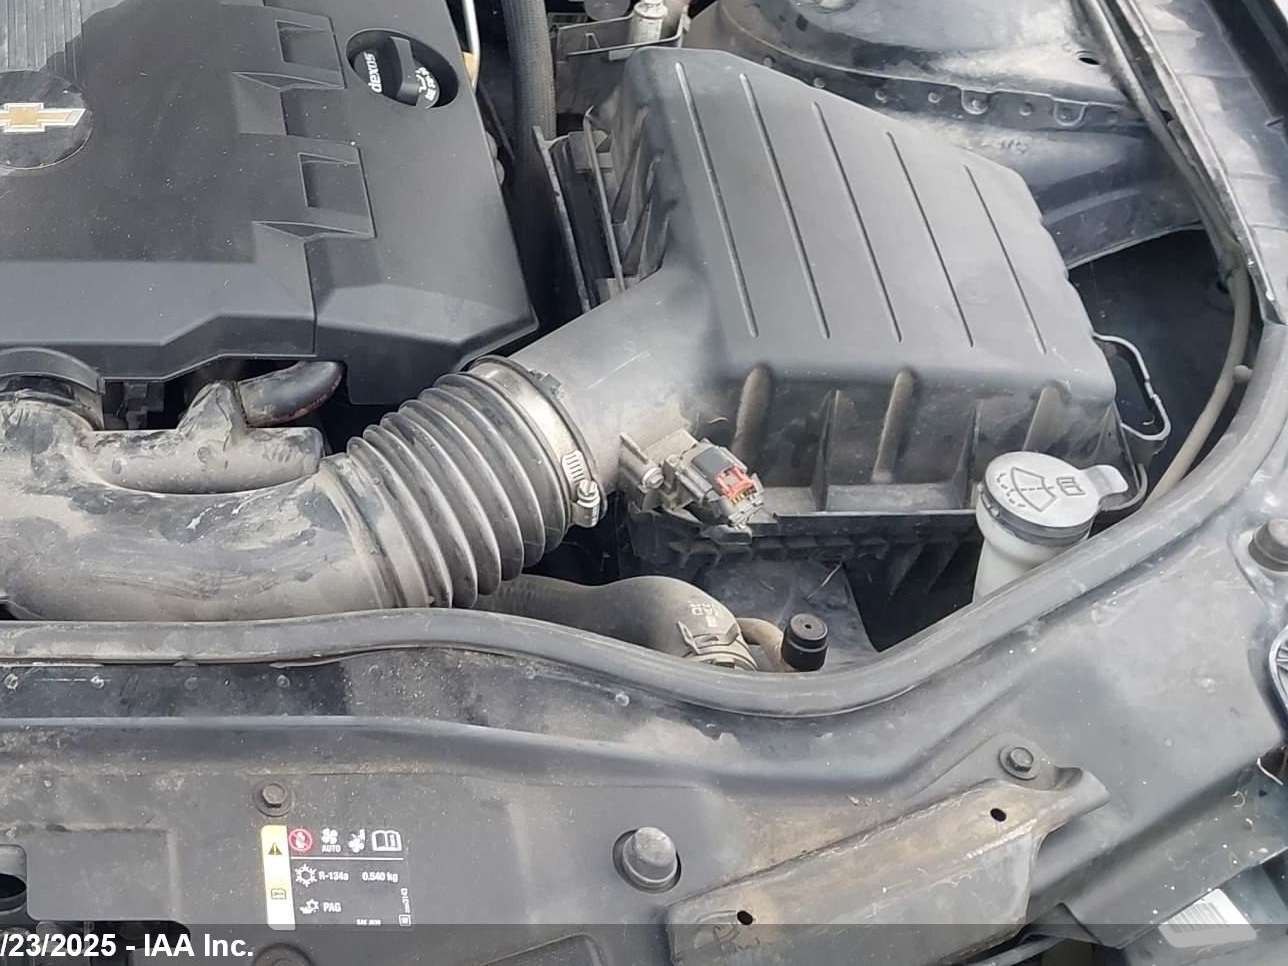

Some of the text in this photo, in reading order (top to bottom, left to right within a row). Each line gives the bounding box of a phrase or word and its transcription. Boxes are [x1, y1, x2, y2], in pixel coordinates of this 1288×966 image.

[363, 51, 382, 93] dexos
[321, 844, 341, 853] AUTO
[318, 871, 349, 881] R-134a
[386, 871, 399, 883] kg
[323, 901, 342, 913] PAG
